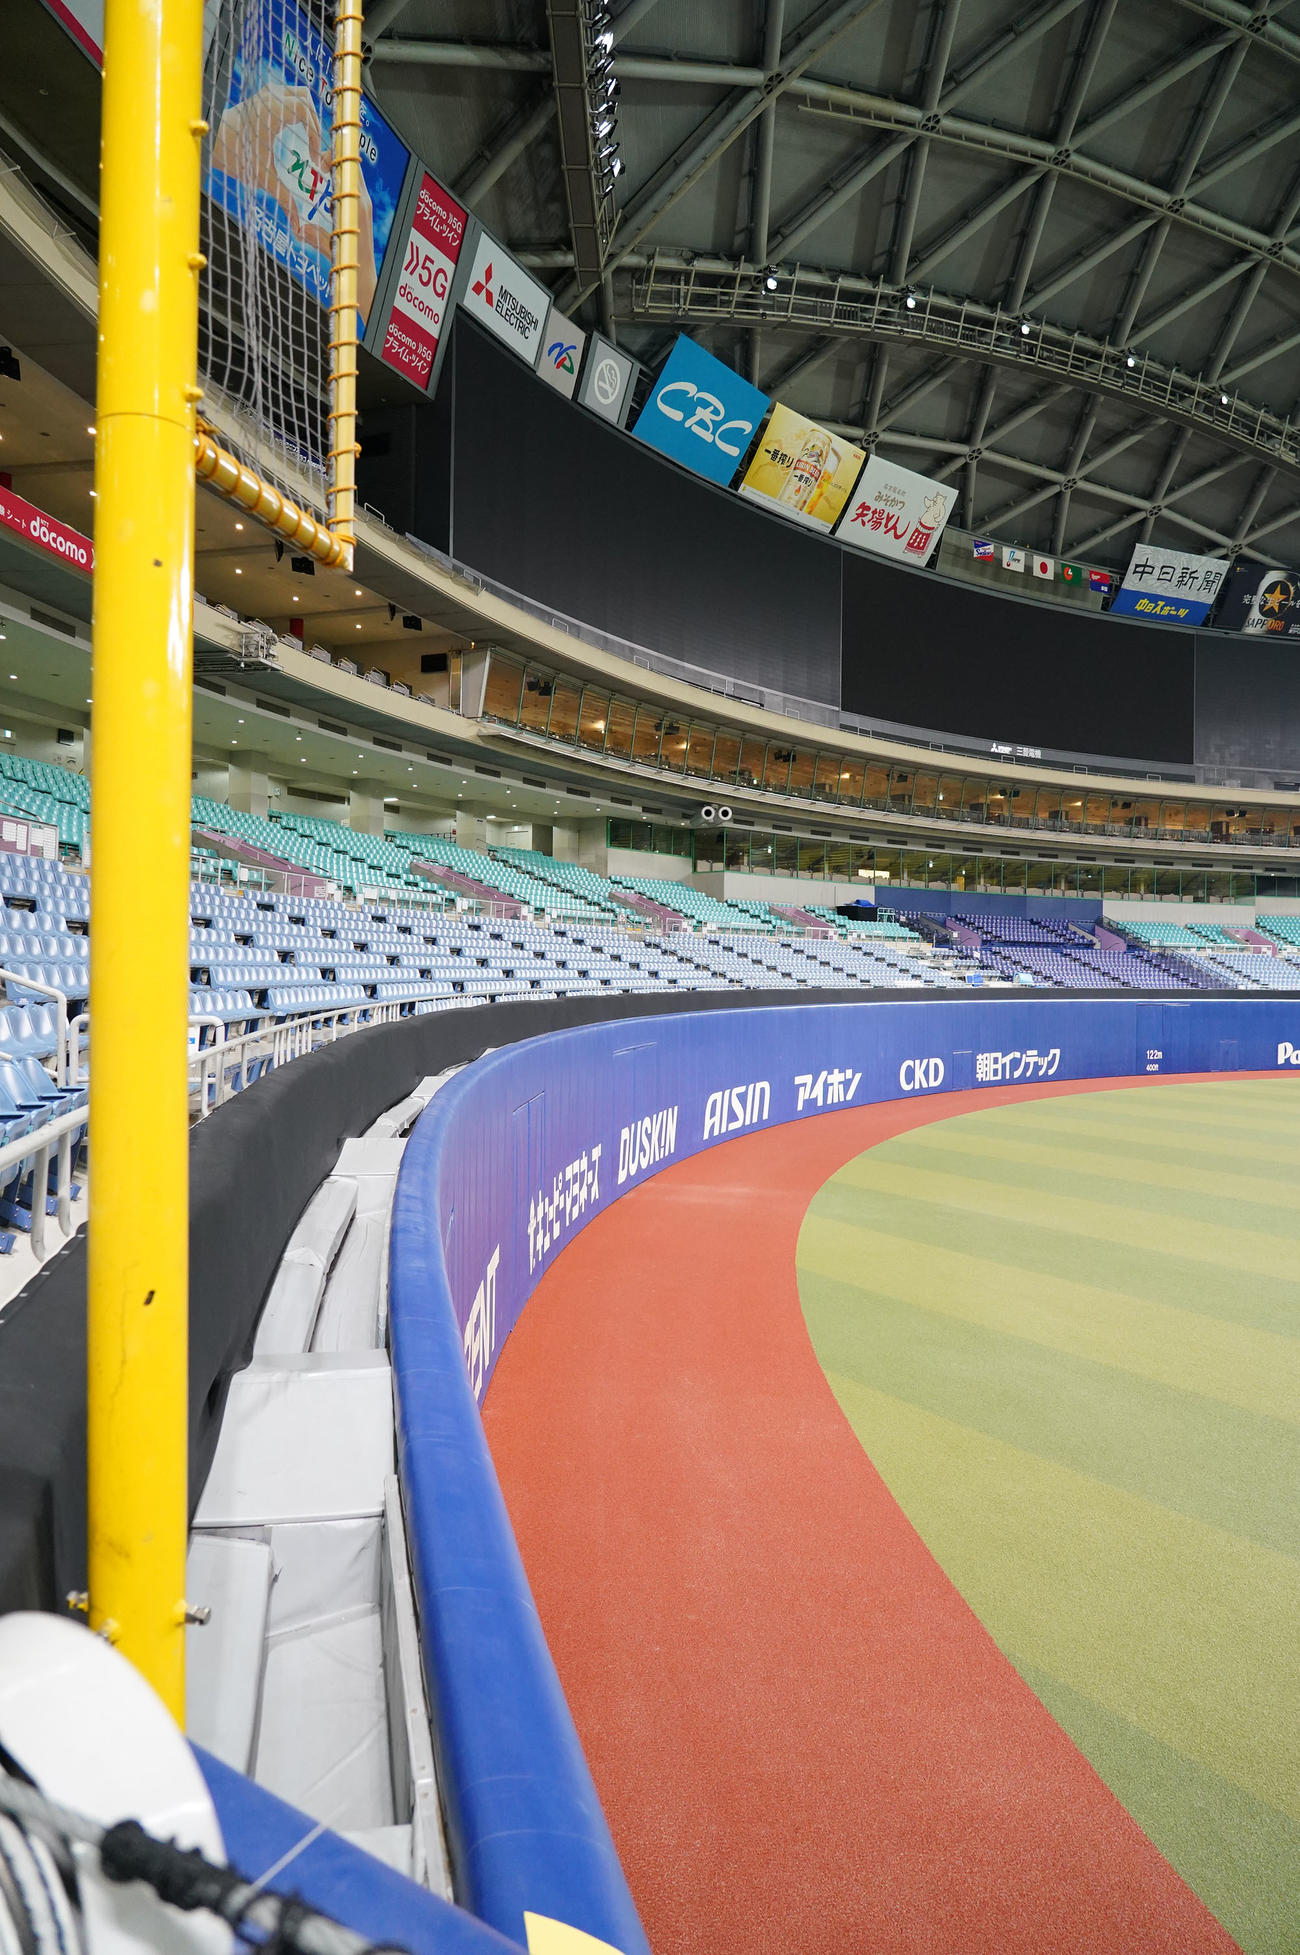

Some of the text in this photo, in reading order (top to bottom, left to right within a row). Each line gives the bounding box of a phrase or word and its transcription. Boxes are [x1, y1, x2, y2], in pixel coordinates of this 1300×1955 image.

[284, 32, 314, 83] Nice
[419, 188, 447, 220] docomo
[398, 282, 440, 325] docomo
[495, 301, 532, 340] ELECTRIC
[498, 284, 539, 331] MITSUBISHI
[388, 322, 417, 351] docomo
[656, 380, 753, 457] CBC
[764, 448, 795, 469] 一番搾り
[849, 500, 911, 540] 矢場とん
[29, 515, 87, 564] docomo
[1132, 557, 1223, 595] 中日新聞
[1134, 598, 1190, 618] 中日スポーツ
[1246, 617, 1286, 632] SAPPORO
[975, 1047, 1062, 1083] 朝日インテック
[1146, 1049, 1163, 1061] 122m
[793, 1067, 863, 1112] アイホン
[899, 1057, 945, 1092] CKD
[702, 1080, 771, 1141] AISIN
